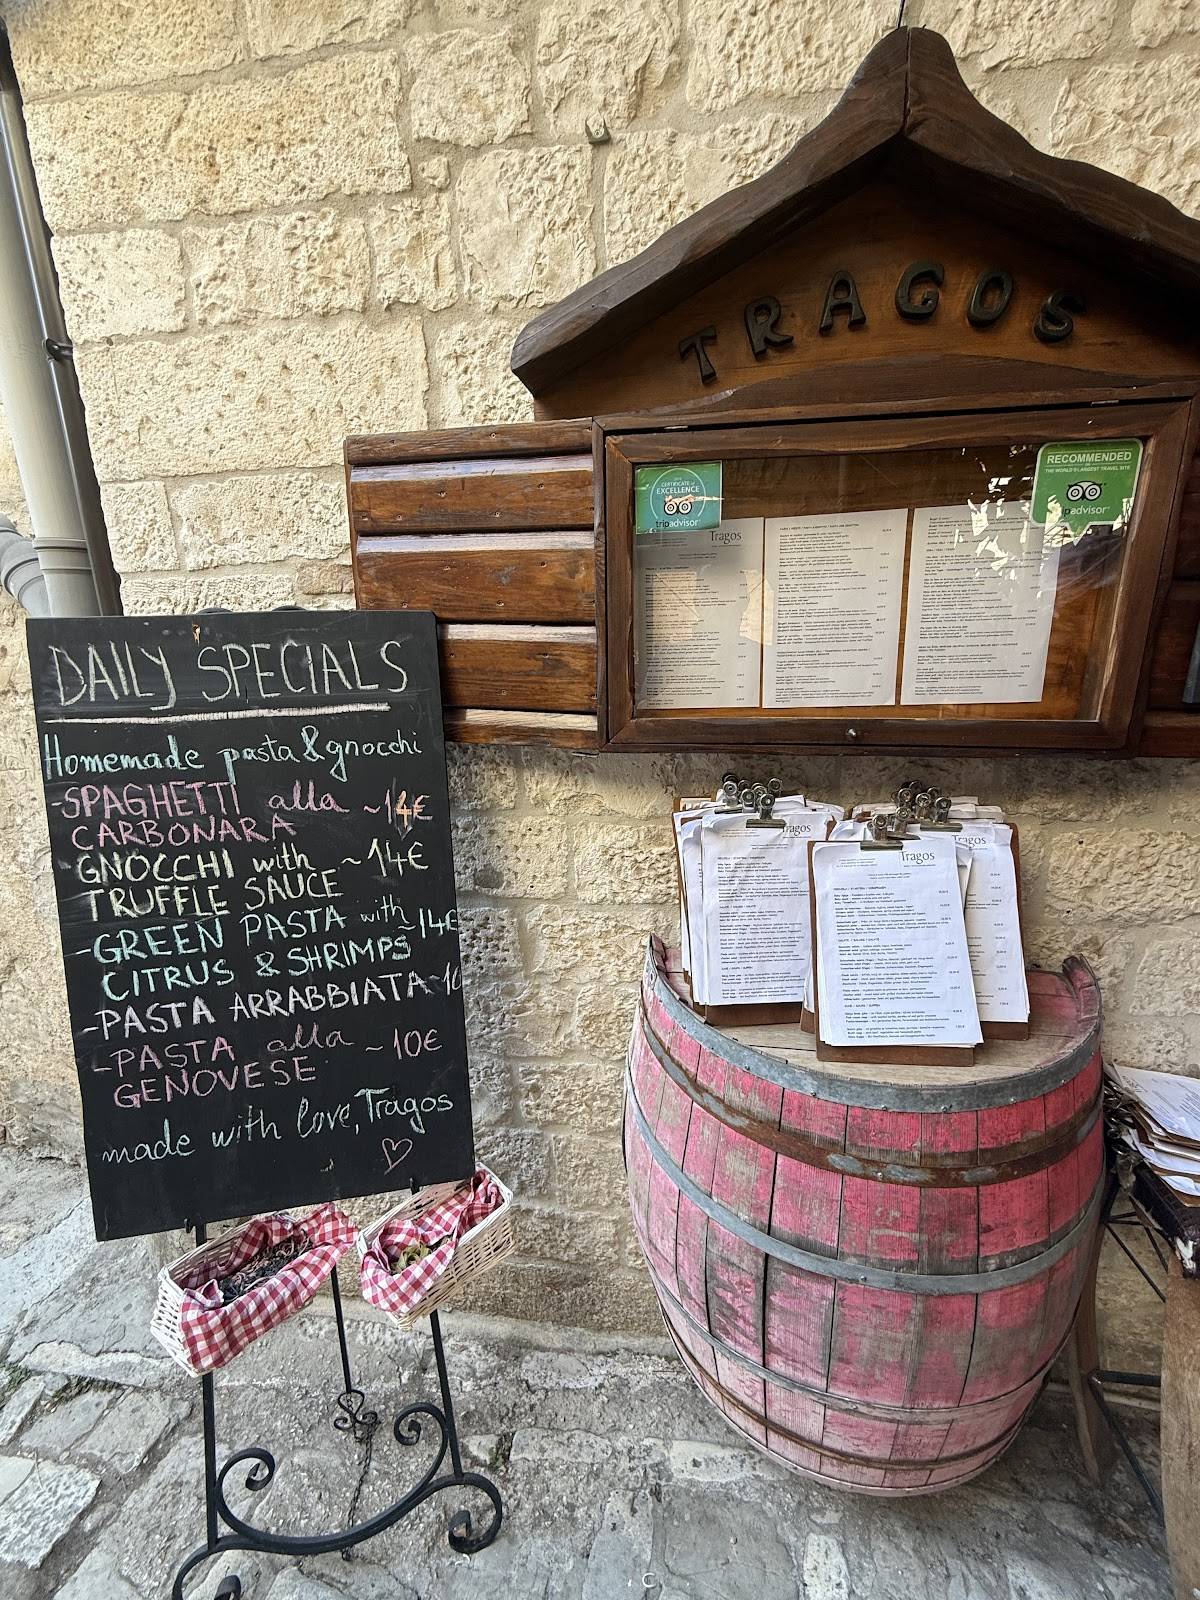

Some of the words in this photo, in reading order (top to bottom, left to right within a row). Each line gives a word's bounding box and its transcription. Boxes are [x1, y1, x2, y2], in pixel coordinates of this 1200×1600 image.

[679, 259, 1086, 384] TRAGOS
[1047, 451, 1132, 464] RECOMMENDED
[656, 485, 700, 495] EXCELLENCE
[656, 519, 699, 529] tripadvisor
[709, 530, 742, 545] Tragos
[49, 640, 177, 711] DAILY
[197, 639, 408, 702] SPECIALS
[44, 733, 205, 780] Homemade
[267, 779, 350, 814] alla
[71, 813, 298, 851] CARBONARA
[252, 842, 317, 873] with
[83, 884, 231, 922] TRUFFLE
[244, 868, 345, 911] SAUCE
[239, 904, 348, 947] PASTA
[360, 894, 410, 923] with
[101, 958, 235, 1001] CITRUS
[286, 934, 411, 976] SHRIMPS
[266, 1022, 355, 1052] alla
[114, 1055, 317, 1109] GENOVESE
[102, 1118, 196, 1163] made
[211, 1105, 282, 1148] with
[354, 1087, 454, 1135] Tragos
